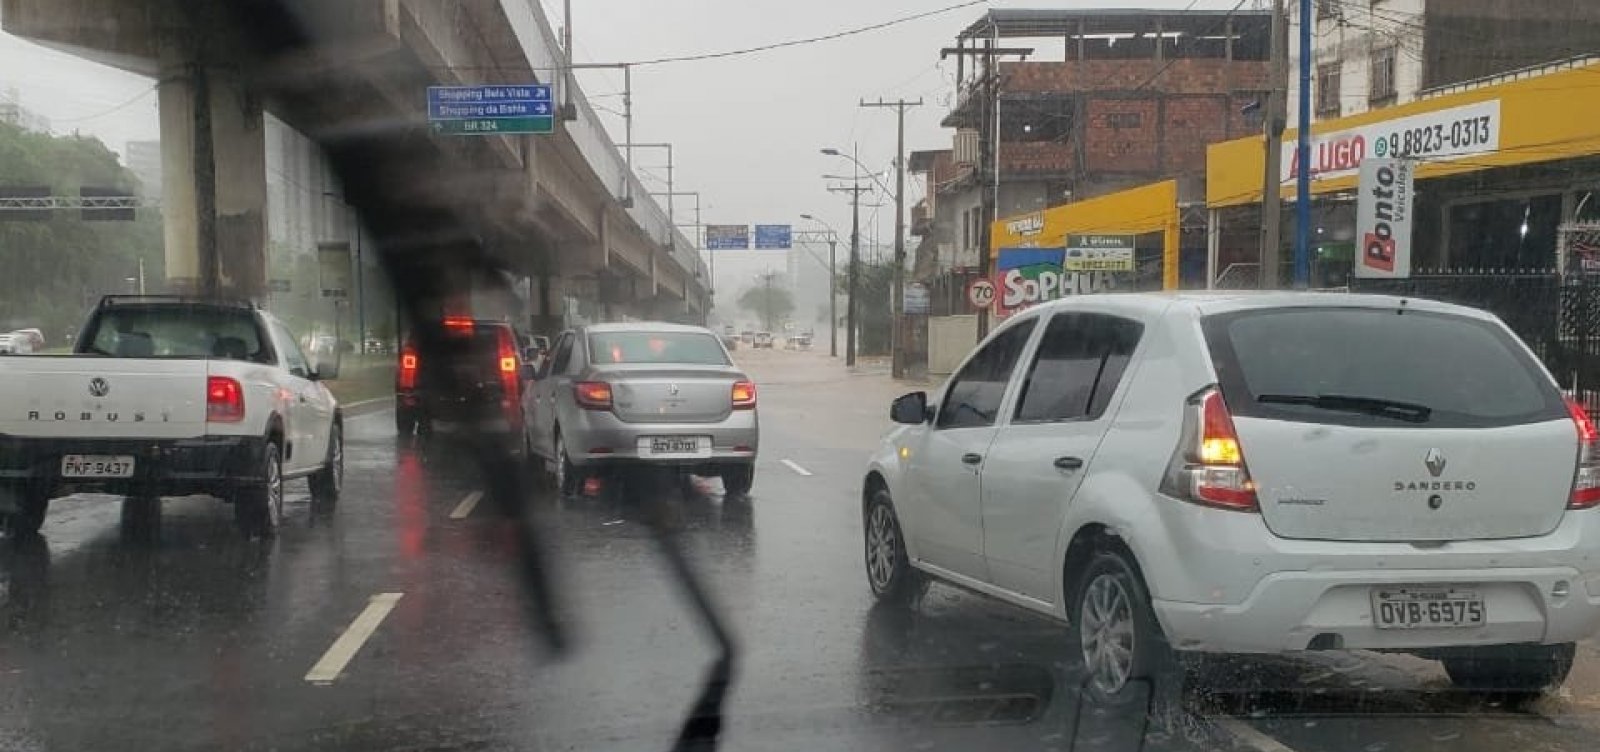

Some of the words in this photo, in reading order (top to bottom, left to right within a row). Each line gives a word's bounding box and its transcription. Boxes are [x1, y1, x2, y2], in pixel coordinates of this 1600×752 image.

[440, 88, 482, 100] Shopping
[506, 88, 530, 98] Vista
[440, 105, 484, 115] Shopping
[486, 105, 497, 114] da
[500, 104, 526, 114] Bahia
[464, 121, 477, 130] BR
[480, 121, 497, 130] 324
[973, 286, 993, 299] 70
[28, 410, 169, 422] ROBUST
[1394, 481, 1476, 491] SANDERO
